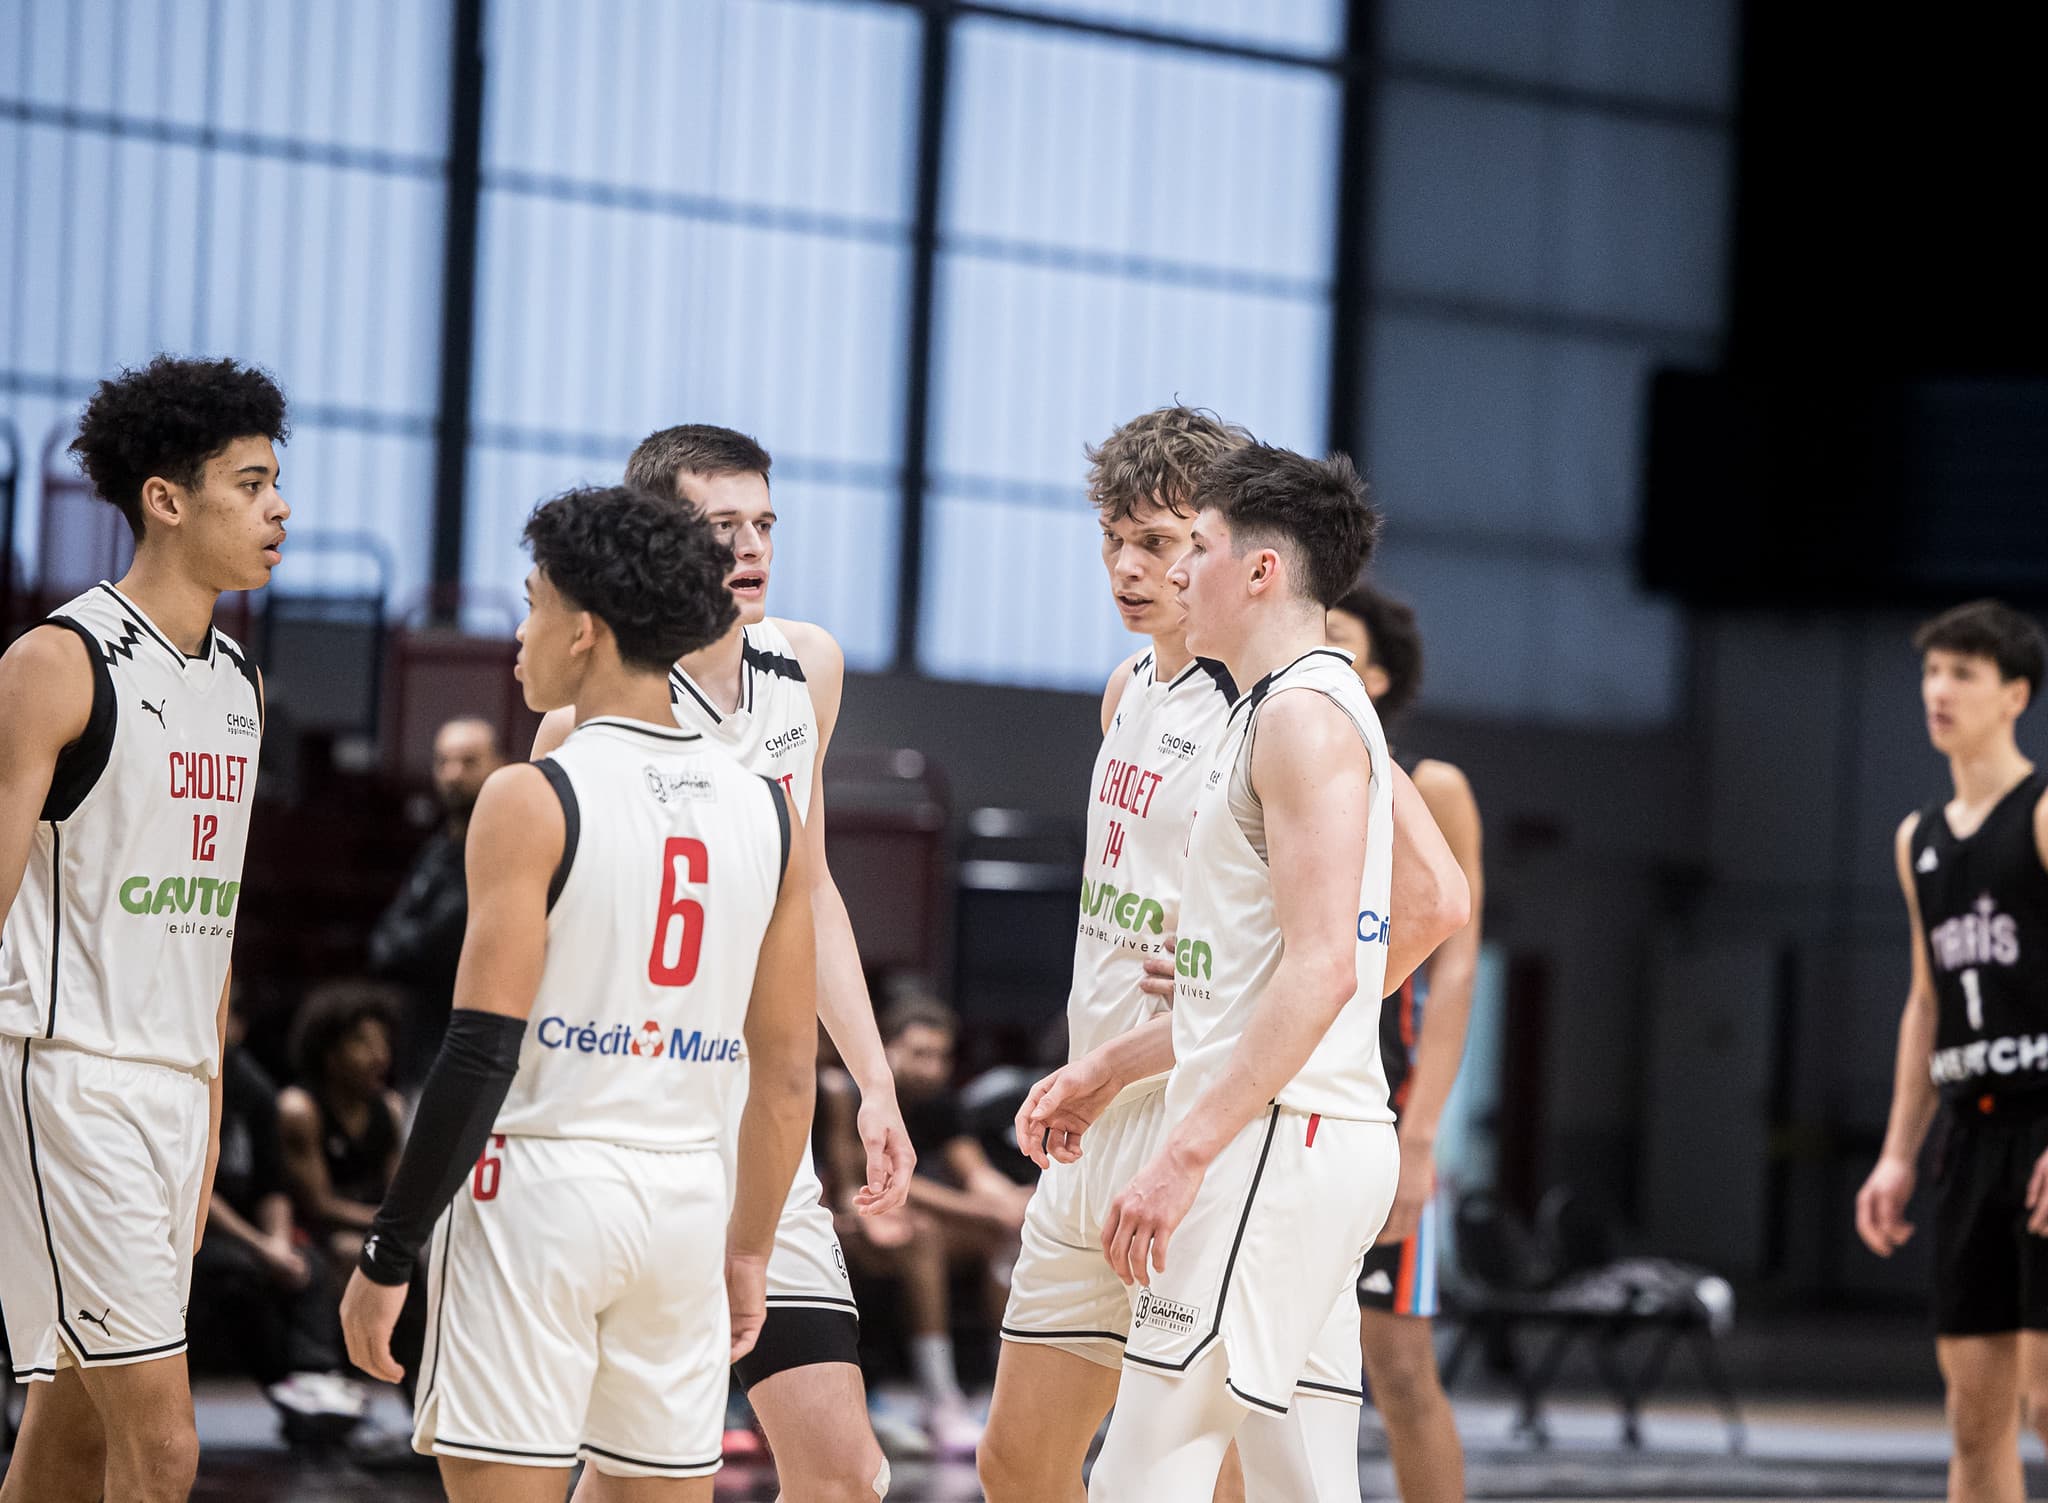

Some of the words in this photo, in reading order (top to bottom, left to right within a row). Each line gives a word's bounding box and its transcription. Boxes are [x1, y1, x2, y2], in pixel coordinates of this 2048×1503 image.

[169, 751, 248, 803] CHOLET
[1100, 758, 1163, 819] CHOET
[192, 814, 218, 862] 12
[1102, 820, 1126, 868] 14
[648, 836, 709, 987] 6
[1180, 983, 1212, 1000] Vivez
[1959, 968, 1984, 1031] 1
